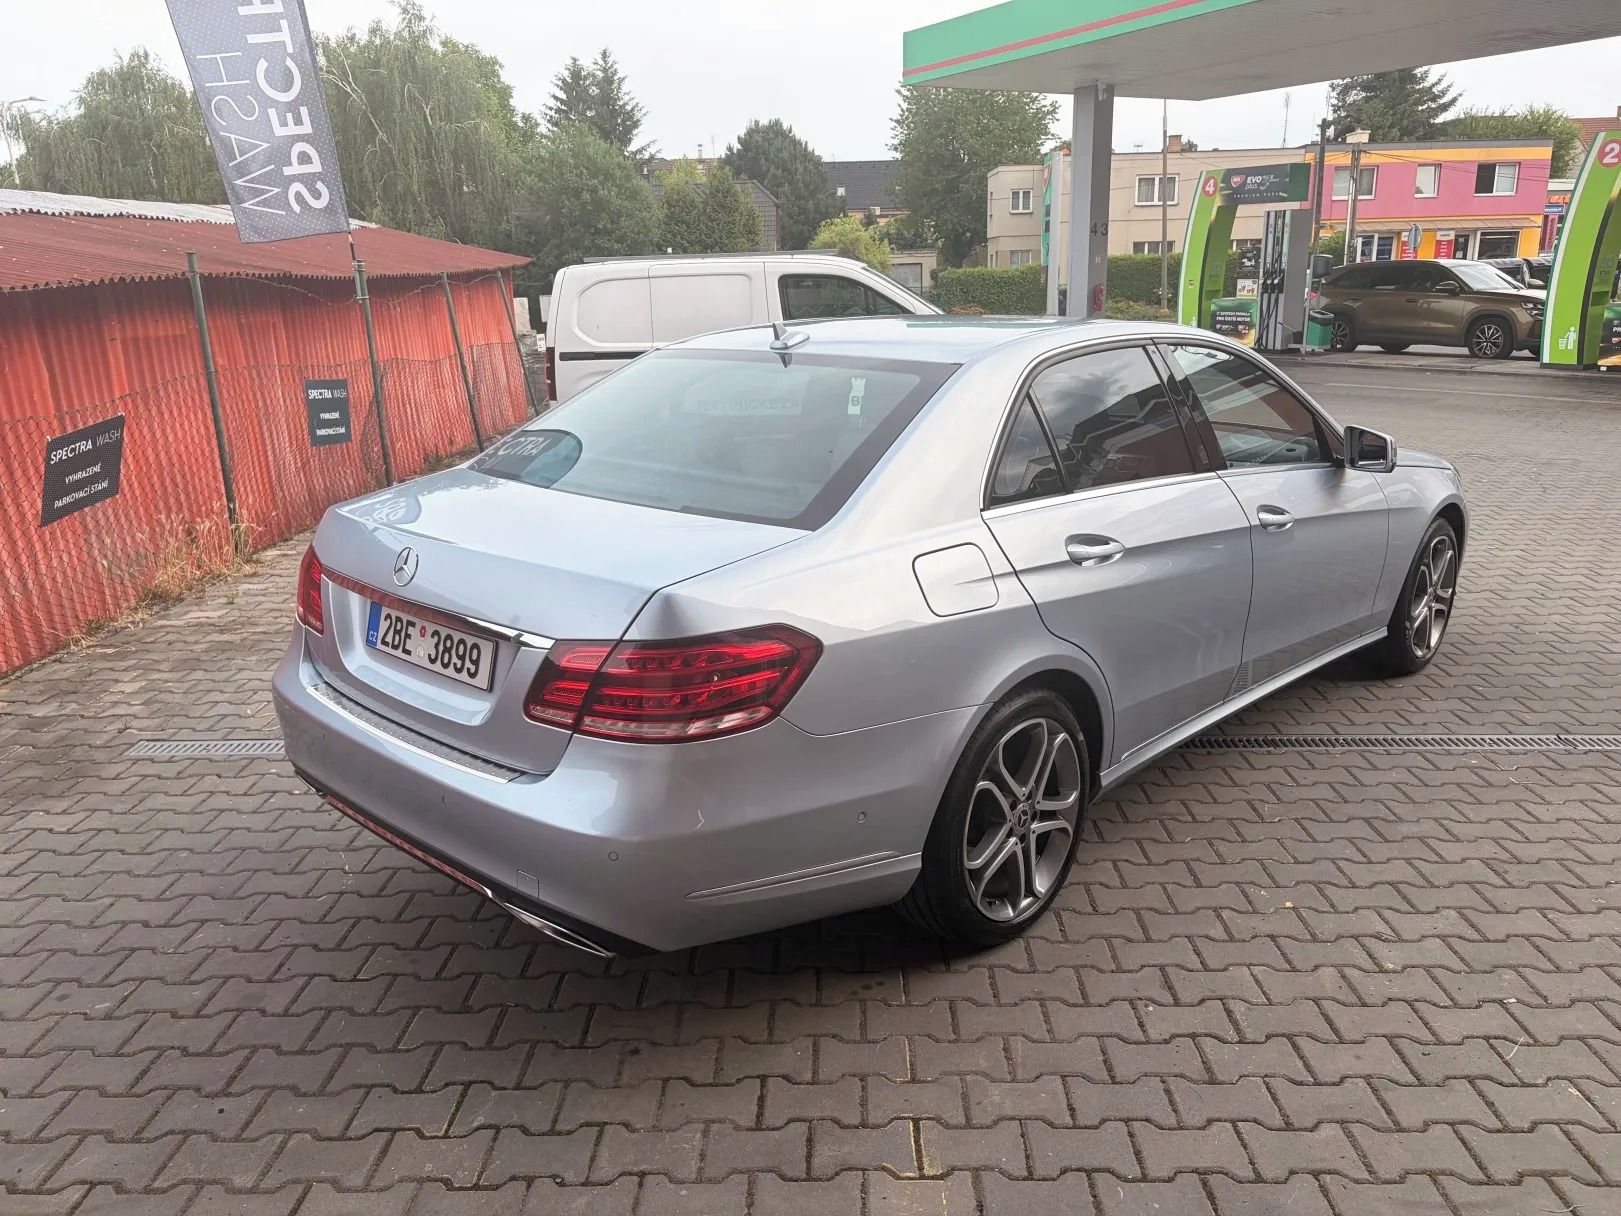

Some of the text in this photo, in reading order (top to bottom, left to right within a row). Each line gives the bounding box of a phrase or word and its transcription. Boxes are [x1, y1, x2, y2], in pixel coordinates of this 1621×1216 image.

[1602, 142, 1621, 164] 2
[1205, 179, 1215, 194] 4
[1246, 175, 1262, 184] EVO
[308, 389, 332, 399] SPECTRA
[851, 396, 860, 406] B
[50, 428, 121, 464] SPECTRA WASH
[65, 461, 101, 484] VYHRAZENÉ
[54, 477, 109, 509] PARKOVACÍ STÁNÍ
[368, 631, 378, 642] CZ
[380, 612, 481, 679] 2BE 3899
